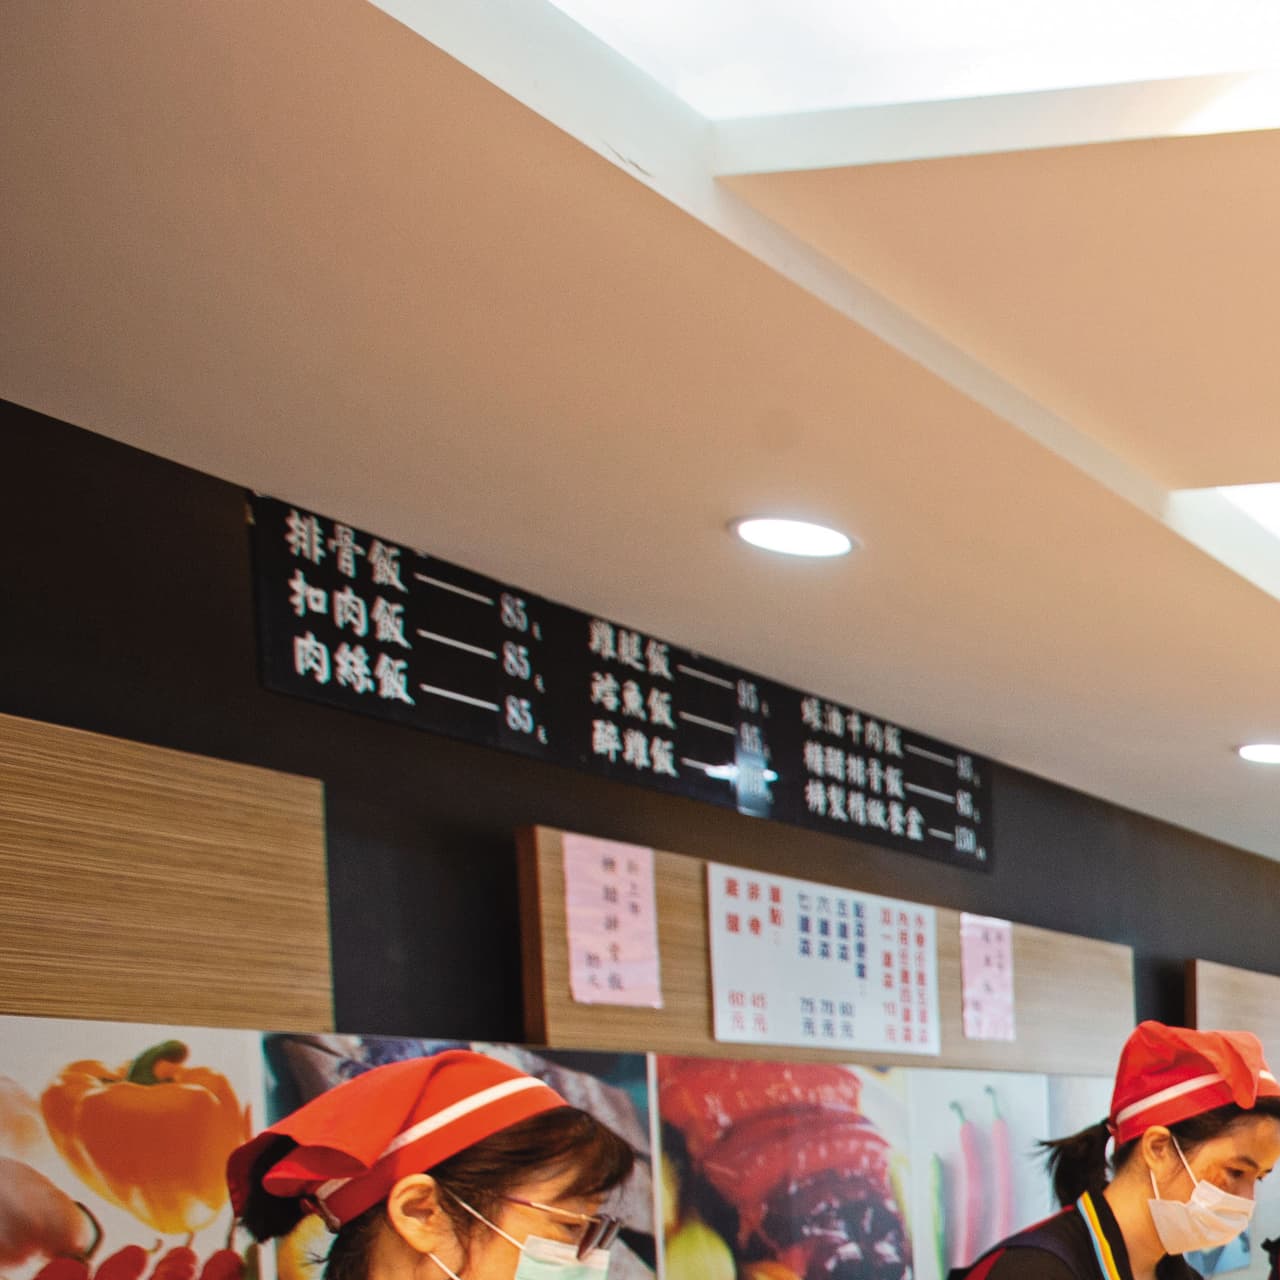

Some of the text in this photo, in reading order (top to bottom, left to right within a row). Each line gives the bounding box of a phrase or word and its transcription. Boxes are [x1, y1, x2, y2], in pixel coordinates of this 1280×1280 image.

[285, 509, 409, 593] 排骨飯
[288, 567, 413, 650] 扣肉飯
[293, 630, 417, 706] 肉絲飯
